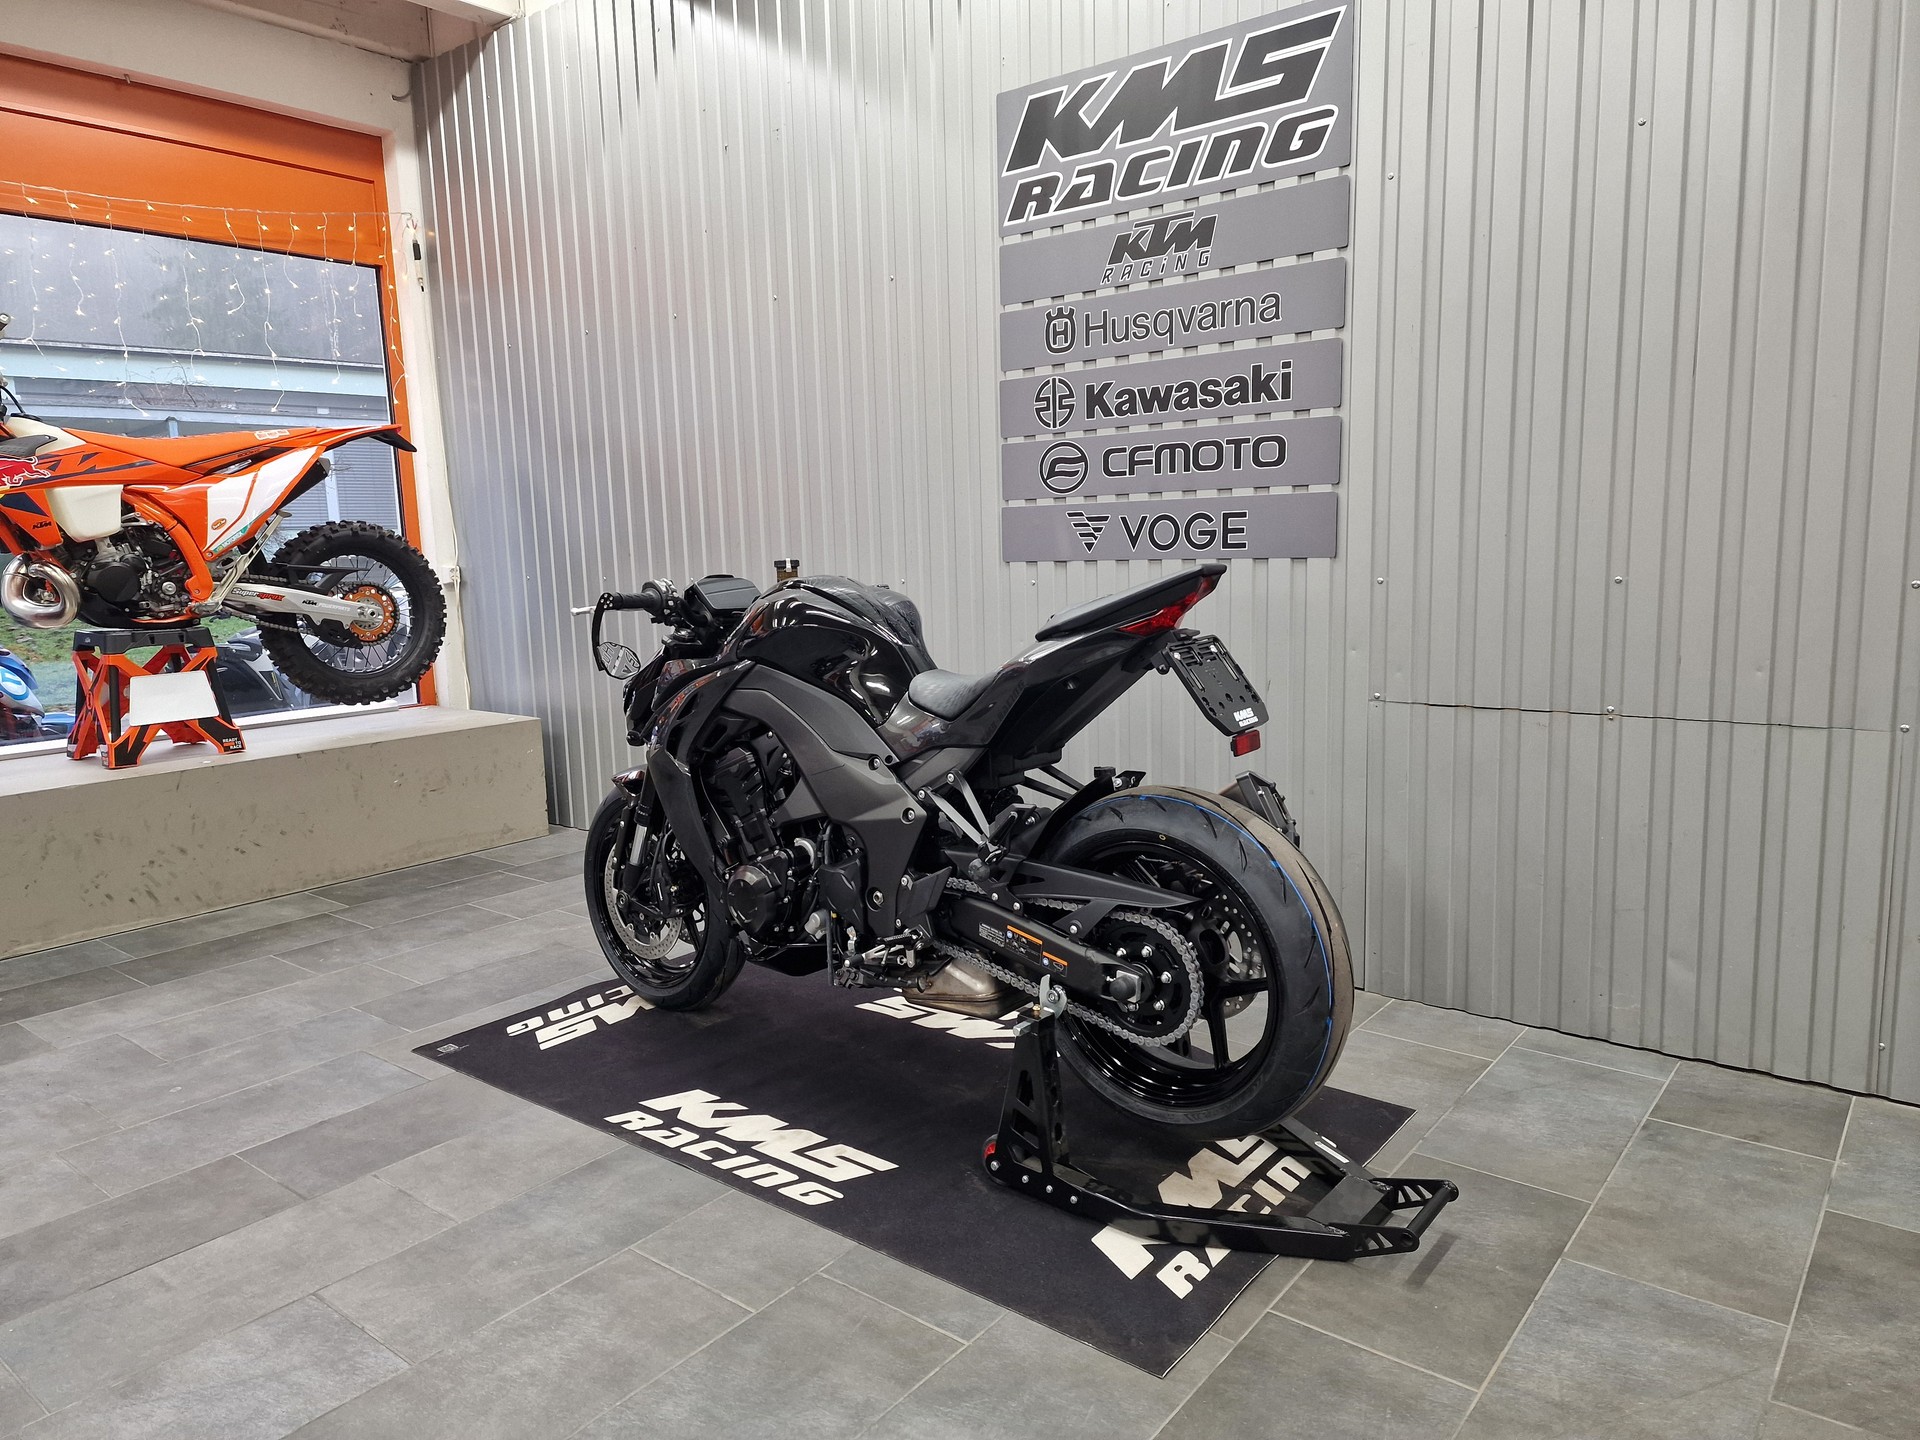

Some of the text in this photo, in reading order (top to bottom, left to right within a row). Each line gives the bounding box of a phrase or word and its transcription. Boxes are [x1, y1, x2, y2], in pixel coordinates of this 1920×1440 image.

[1001, 5, 1347, 177] KMS
[1003, 105, 1339, 227] RACING
[1107, 210, 1218, 266] KTM
[1083, 292, 1282, 348] Husqvarna
[1084, 359, 1293, 421] Kawasaki
[1101, 434, 1288, 477] CFMOTO
[32, 520, 52, 530] KTM
[1119, 510, 1248, 552] VOGE
[302, 599, 318, 607] KTM
[1233, 707, 1254, 722] KMS
[604, 1110, 844, 1206] RACING
[639, 1089, 900, 1183] KMS
